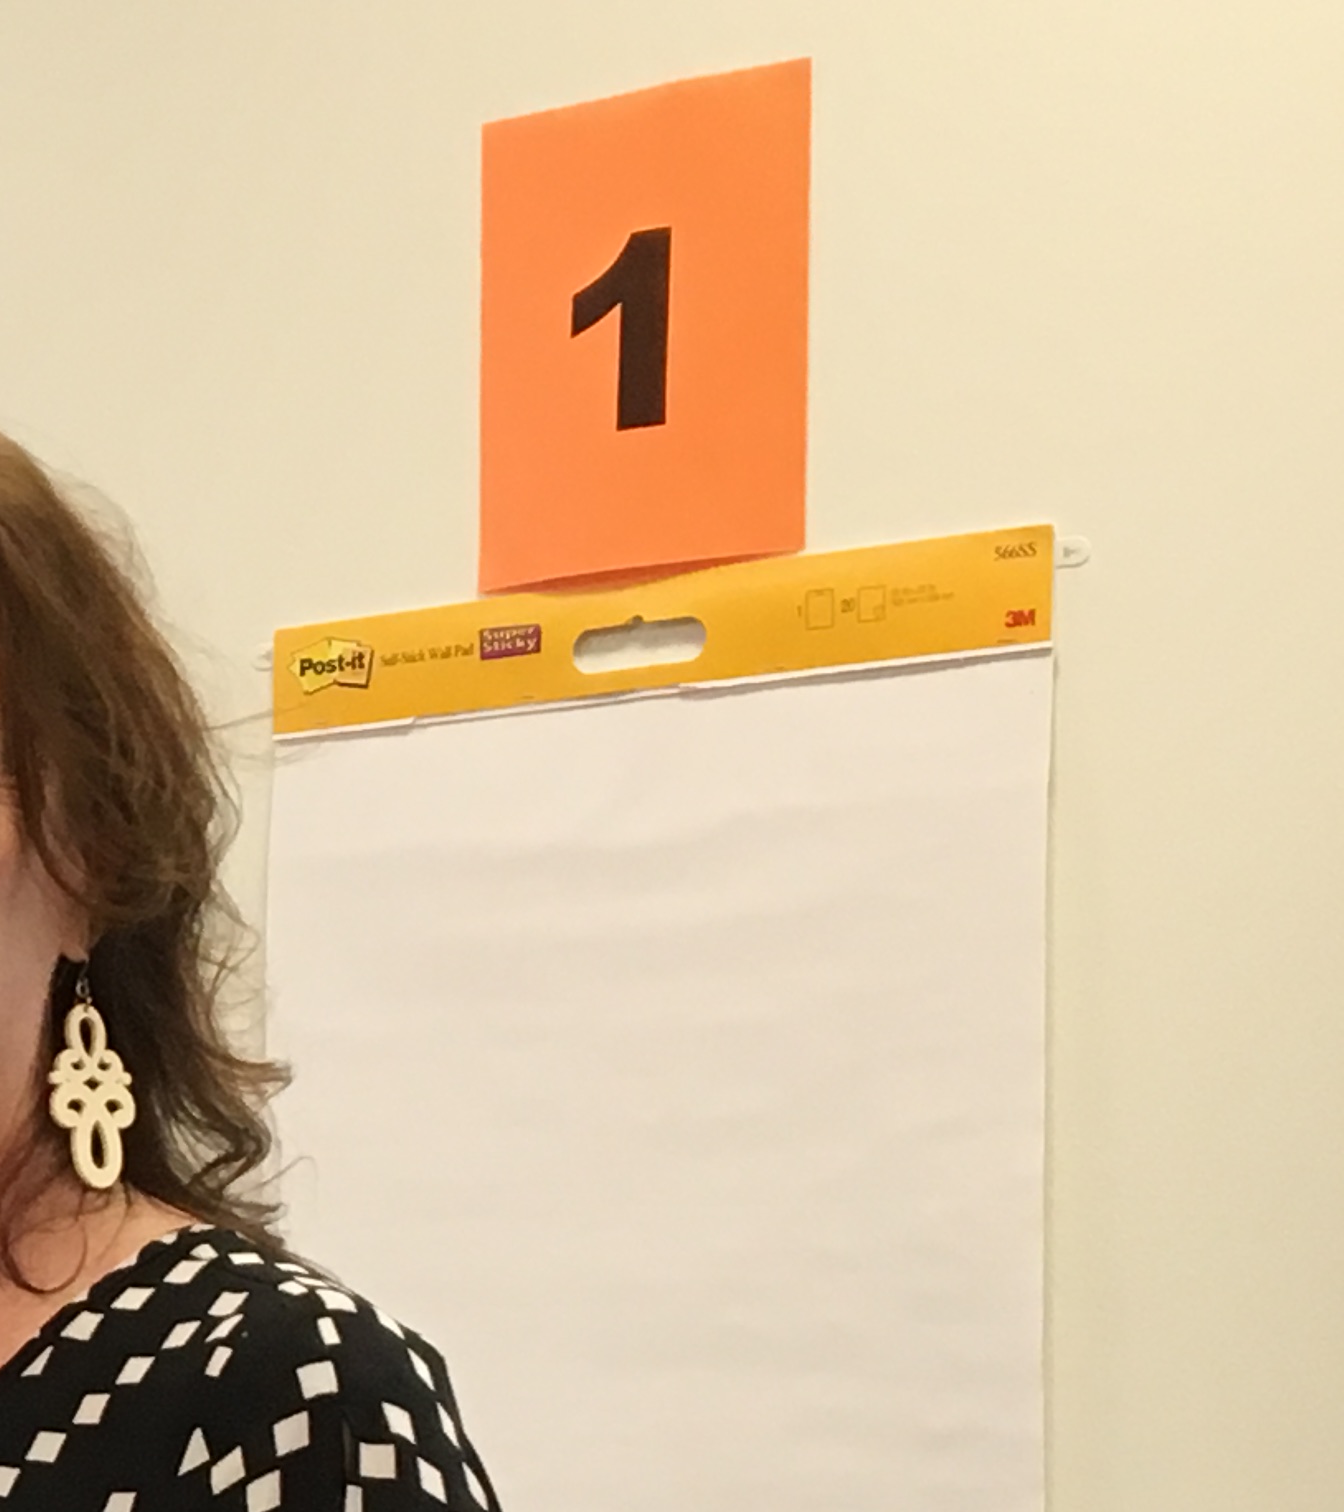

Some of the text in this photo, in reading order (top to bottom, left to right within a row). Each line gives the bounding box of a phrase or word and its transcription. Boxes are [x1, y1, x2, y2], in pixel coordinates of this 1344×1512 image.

[571, 226, 672, 431] 1
[1005, 609, 1036, 628] 3M
[482, 625, 535, 641] Super
[482, 637, 538, 653] Sticky
[299, 652, 366, 677] Post-it
